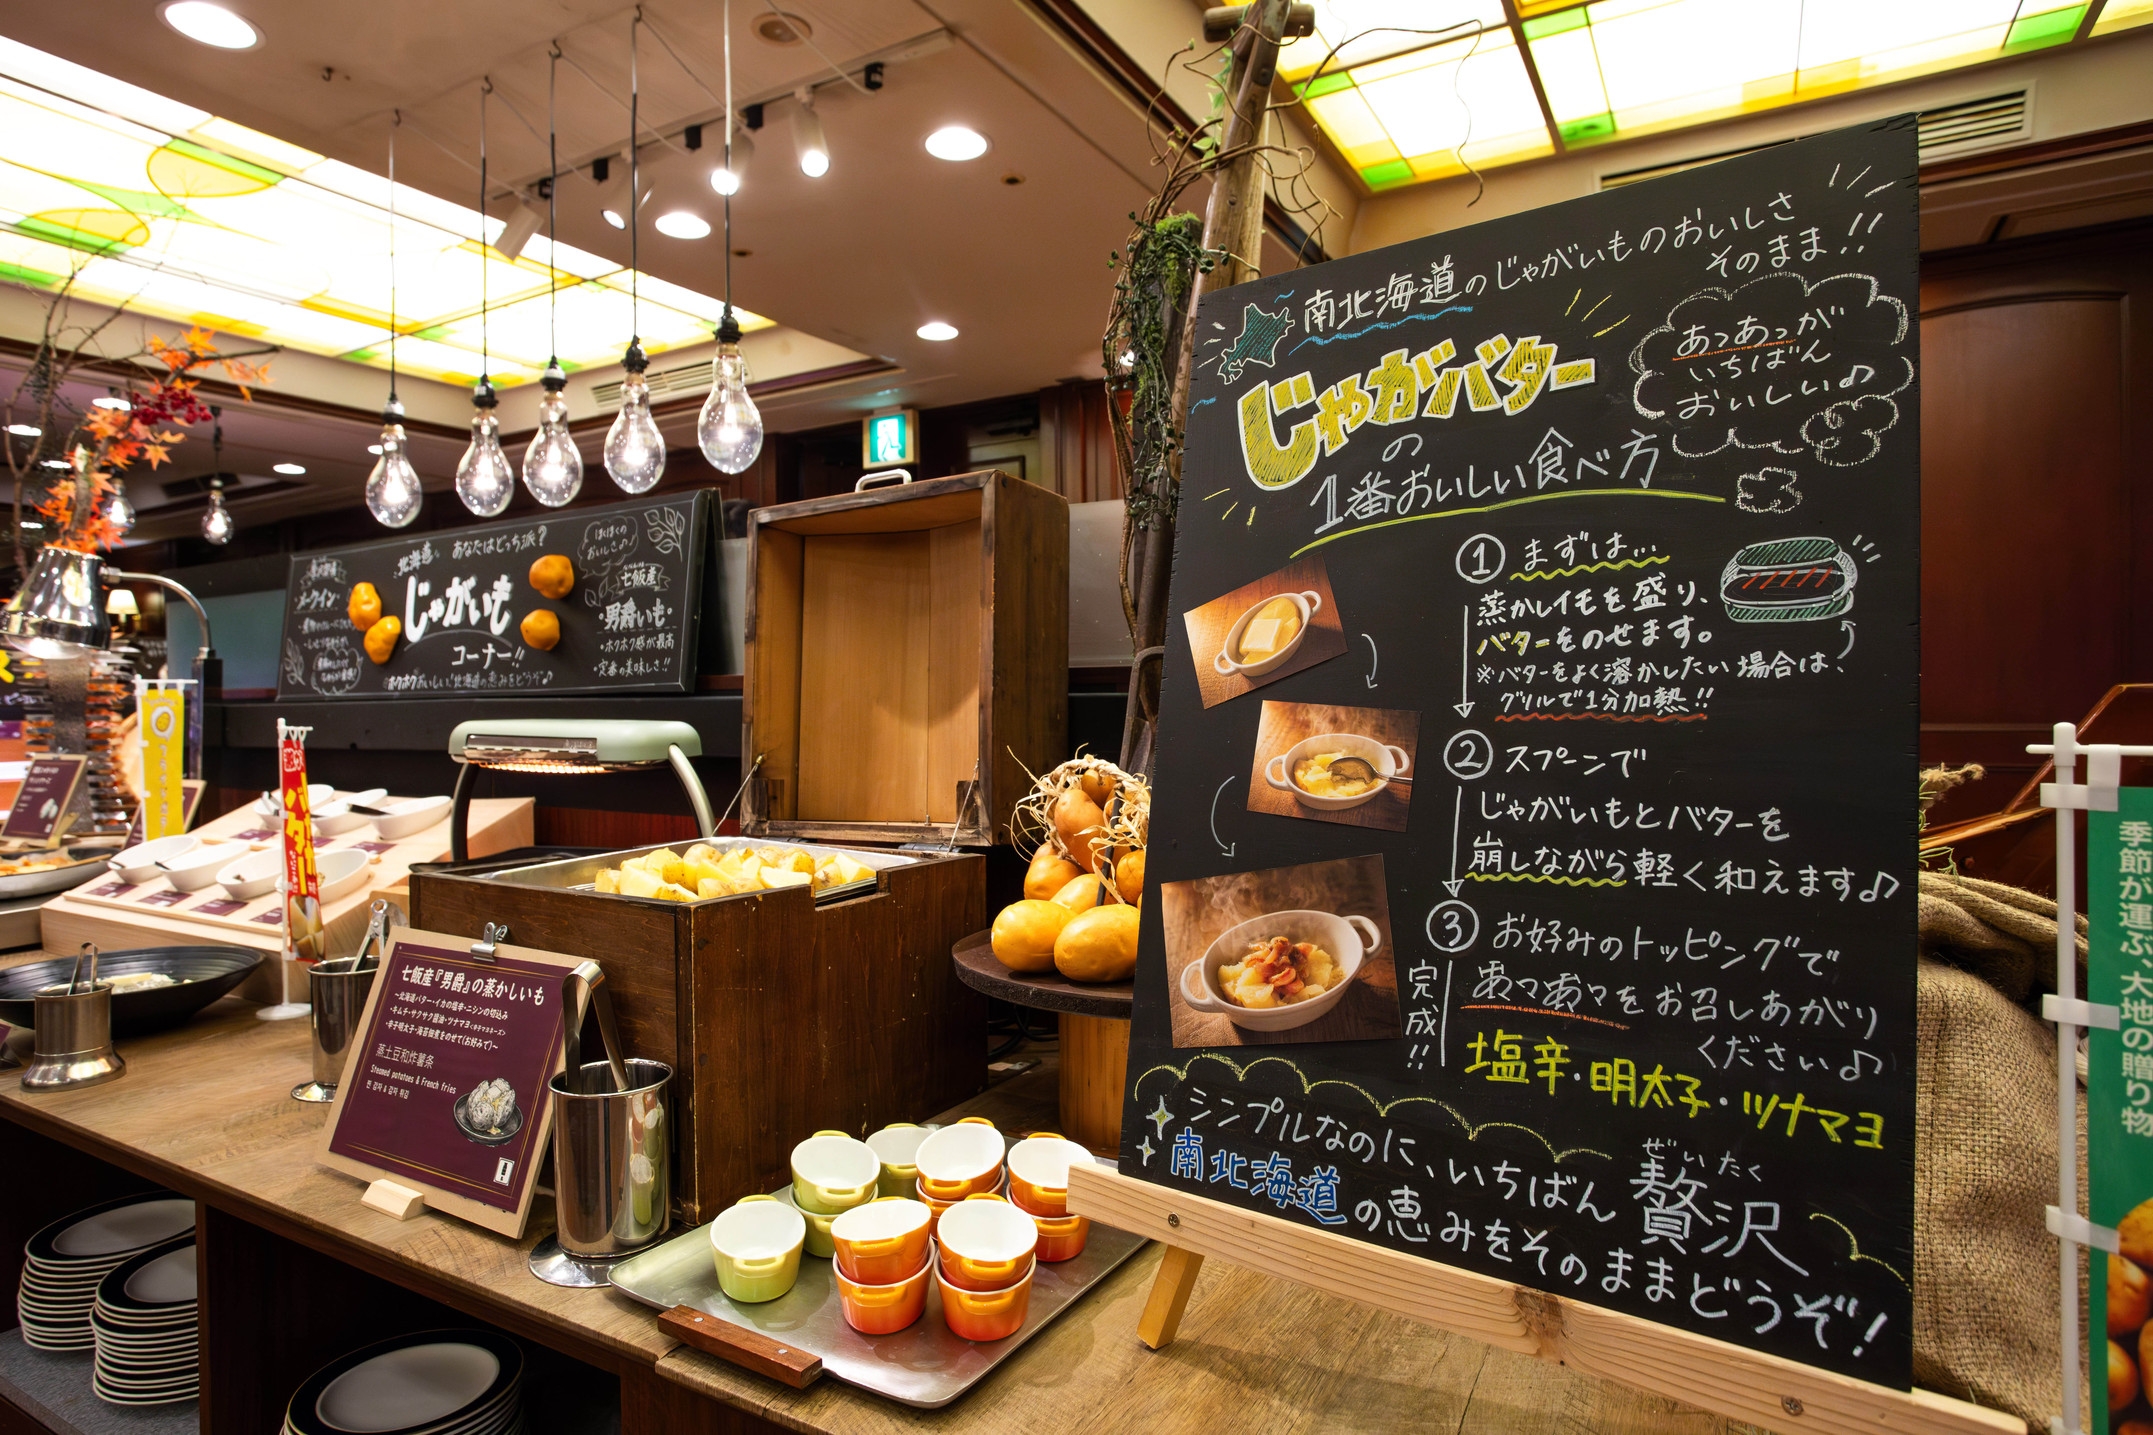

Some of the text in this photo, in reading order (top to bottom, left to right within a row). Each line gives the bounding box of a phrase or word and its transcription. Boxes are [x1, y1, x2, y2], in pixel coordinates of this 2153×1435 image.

[1689, 338, 1832, 382] いちばん
[1237, 333, 1597, 492] じゃがバター
[1382, 433, 1424, 463] の
[1311, 426, 1660, 535] 1番おいしい食べ方
[620, 566, 658, 588] 七飯産
[403, 573, 516, 644] じゃがいも
[1477, 614, 1713, 656] バターをのせます。
[1505, 744, 1647, 780] スプーンで
[1480, 791, 1790, 842] じゃがいもとバターを
[1492, 911, 1840, 977] お好みのトッピングで
[401, 964, 545, 1006] 七飯産『男爵』の蒸かしいも
[2118, 820, 2153, 1138] 季節が運ぶ、大地の贈り物
[370, 1064, 391, 1077] Steamed
[391, 1071, 415, 1084] potatoes
[420, 1077, 440, 1090] French
[440, 1082, 457, 1095] fries
[1641, 1136, 1763, 1182] ぜいたく
